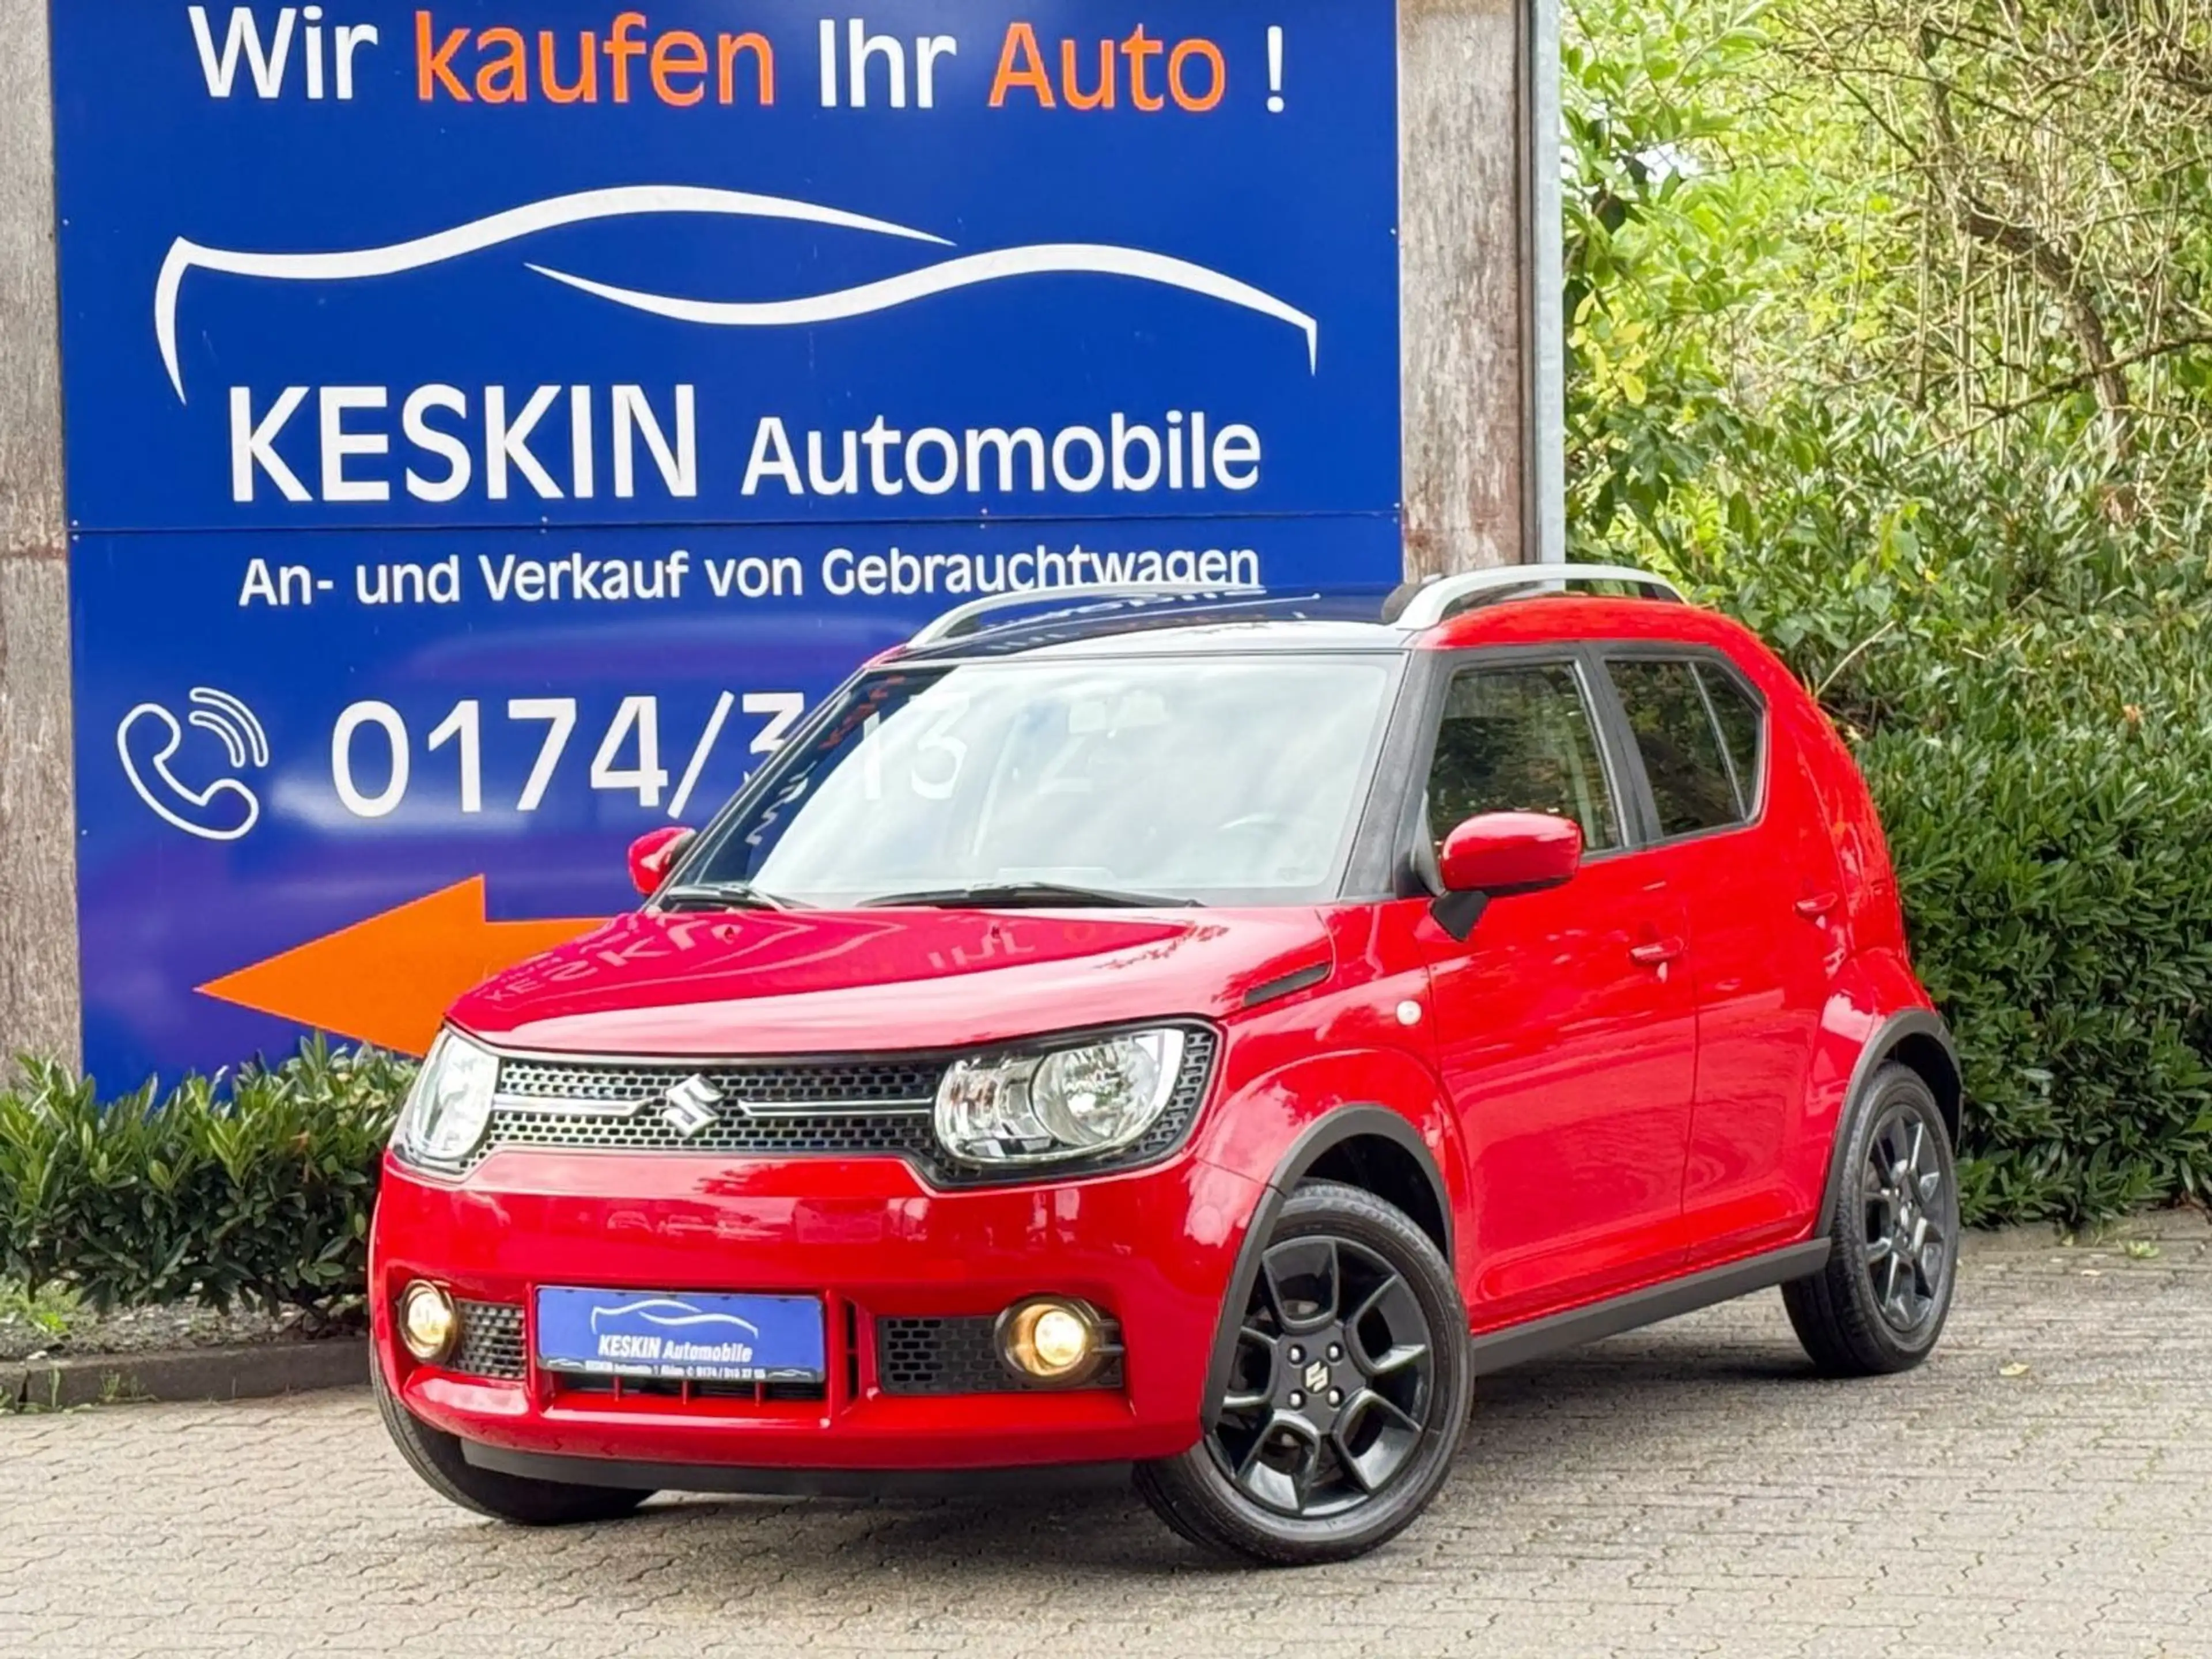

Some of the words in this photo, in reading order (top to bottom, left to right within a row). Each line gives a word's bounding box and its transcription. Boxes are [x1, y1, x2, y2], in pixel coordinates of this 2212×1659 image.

[189, 6, 378, 99] Wir
[416, 11, 775, 107] kaufen
[820, 18, 957, 108] Ihr
[988, 22, 1226, 111] Auto
[1267, 26, 1284, 113] !
[230, 384, 697, 502] KESKIN
[741, 411, 1261, 495] Automobile
[239, 559, 333, 605] An-
[357, 555, 460, 604] und
[479, 550, 689, 601] Verkauf
[704, 558, 802, 597] von
[822, 544, 1259, 599] Gebrauchtwagen
[598, 1334, 661, 1359] KESKIN
[662, 1339, 753, 1363] Automobile
